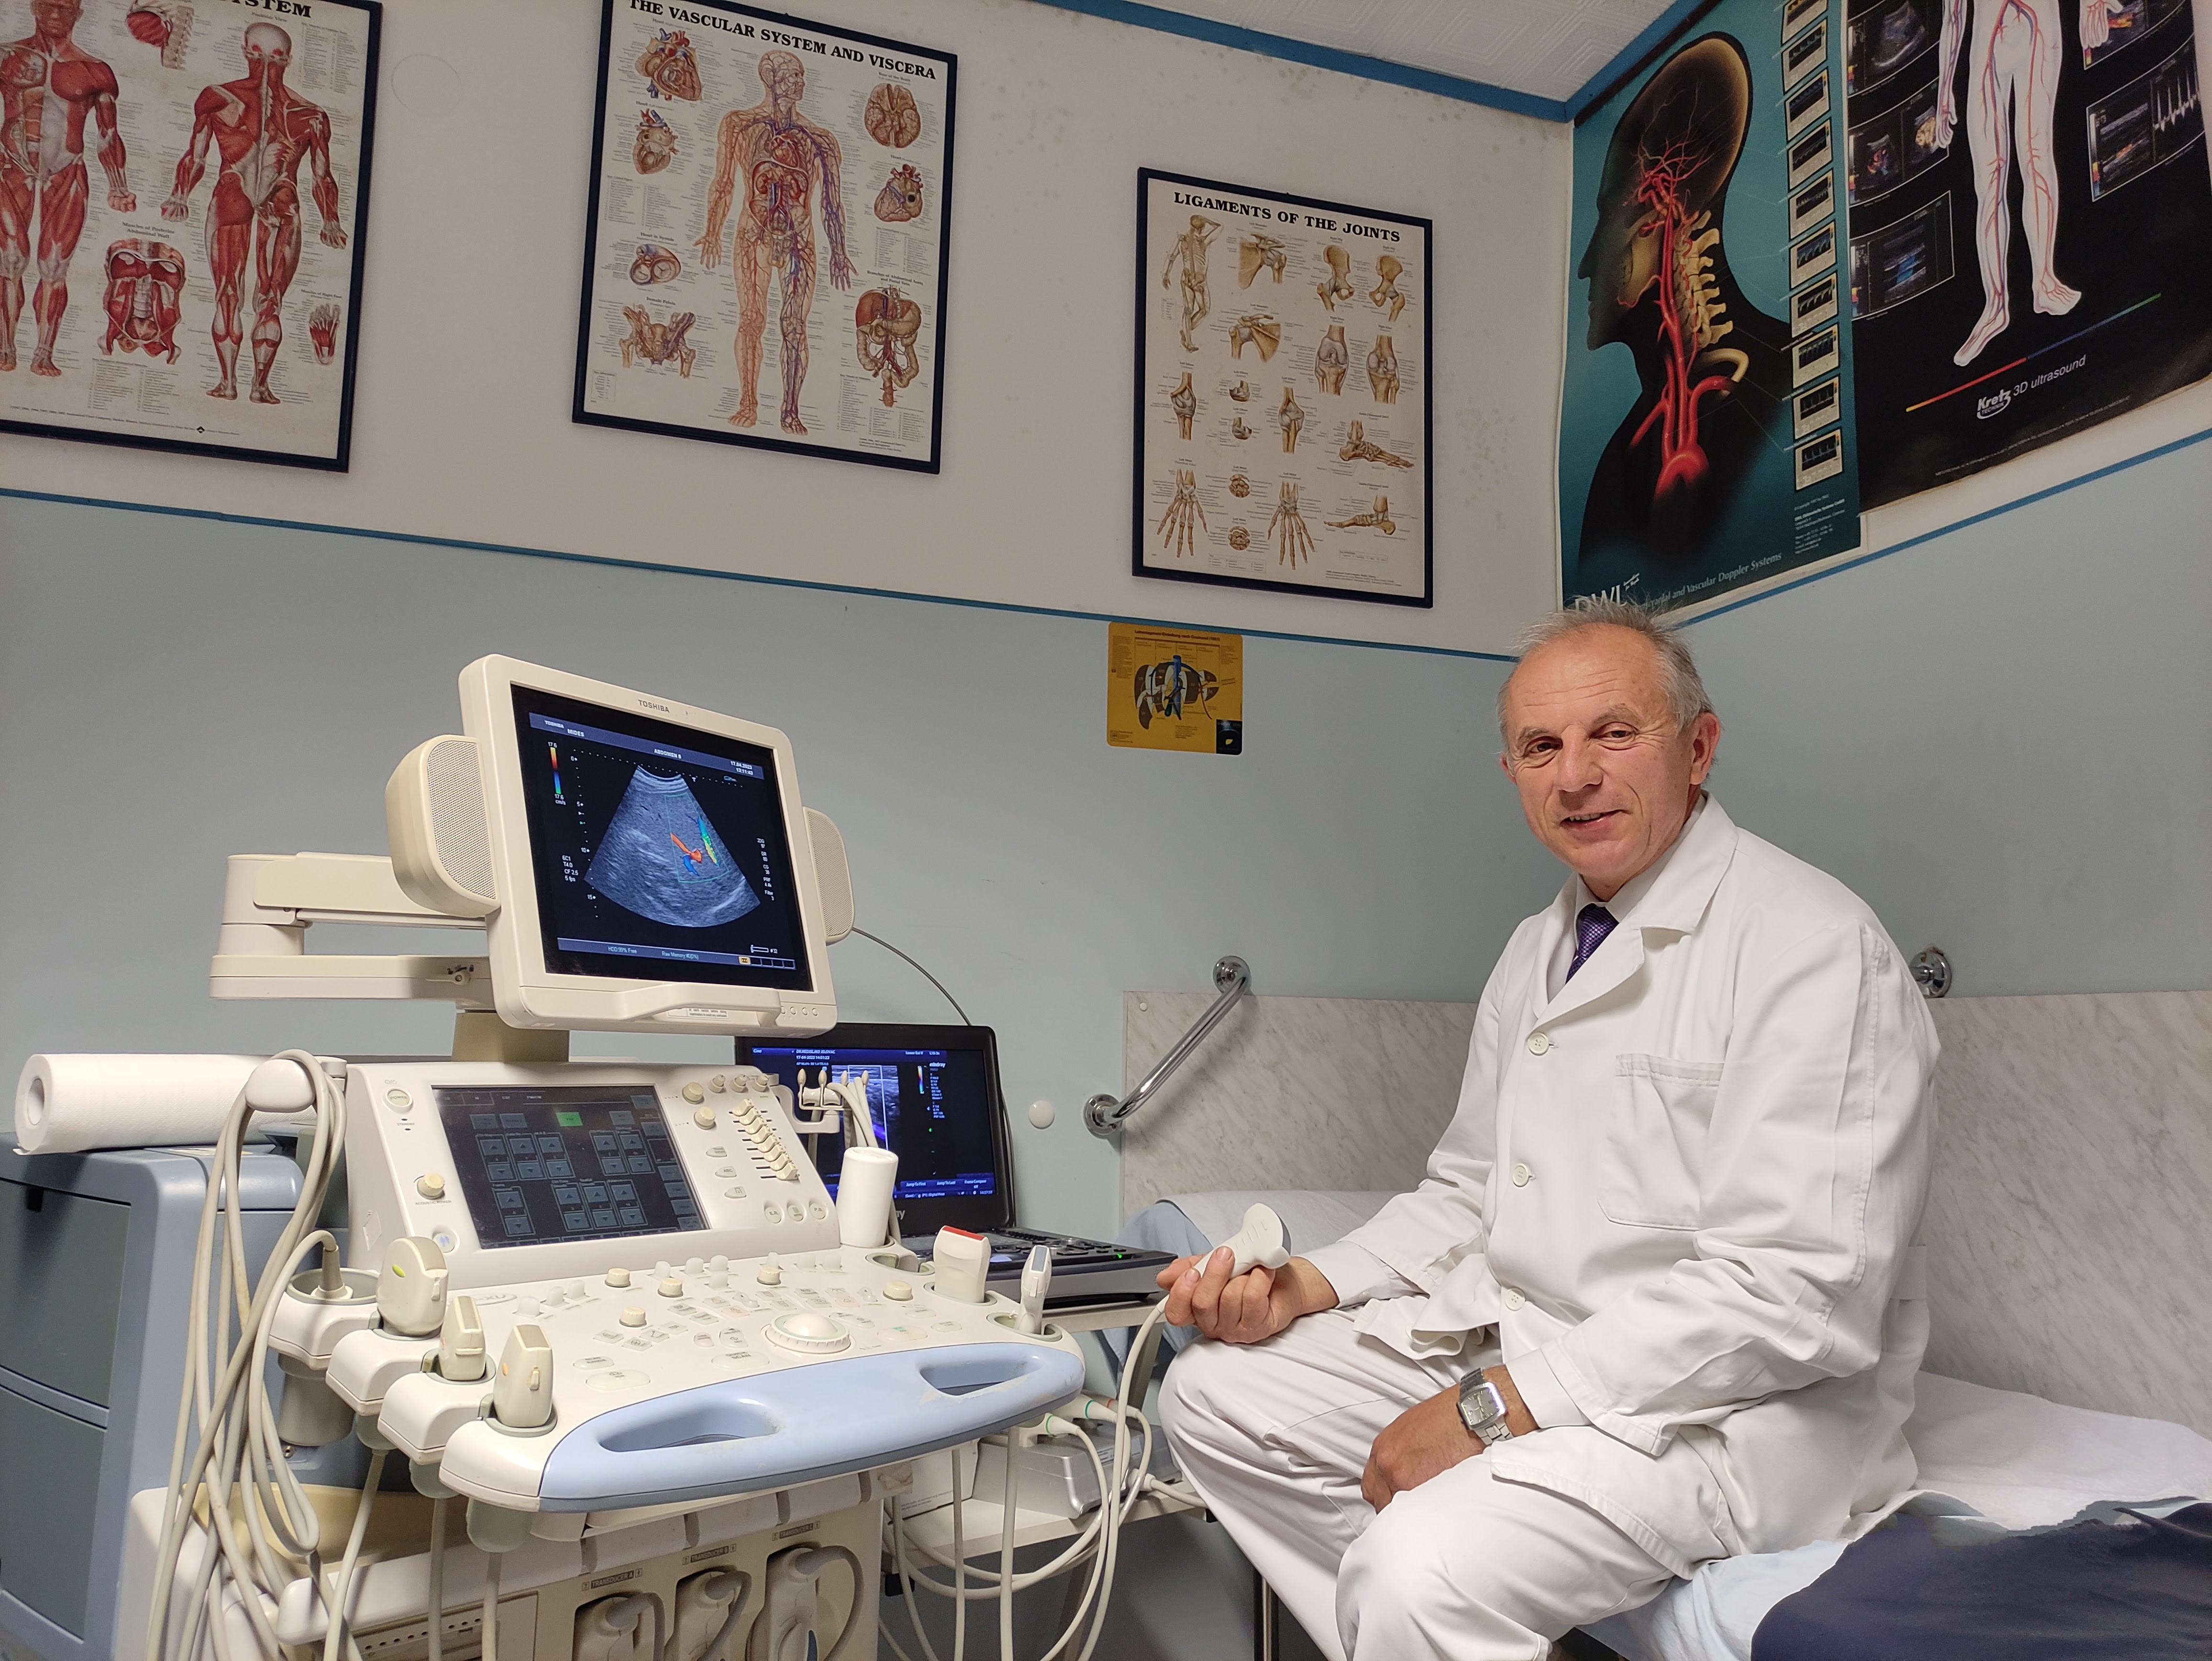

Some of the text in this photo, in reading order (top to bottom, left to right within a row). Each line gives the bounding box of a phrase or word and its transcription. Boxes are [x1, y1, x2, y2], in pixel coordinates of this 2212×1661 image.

[630, 0, 936, 80] THE VASCULAR SYSTEM AND VISCERA
[1174, 192, 1400, 242] LIGAMENTS OF THE JOINTS
[2013, 354, 2086, 396] 3D ultrasound
[1977, 389, 2011, 411] Kretz
[1672, 586, 1685, 598] and
[1687, 576, 1716, 593] Vascular
[1718, 565, 1749, 582] Doppler
[1751, 553, 1782, 572] Systems
[638, 699, 670, 713] TOSHIBA
[544, 720, 564, 728] TOSHIBA
[567, 729, 585, 737] MIDES
[654, 748, 677, 758] ABDOMEN
[691, 1548, 723, 1562] TRANSDUCER
[592, 1572, 628, 1588] TRANSDUCER
